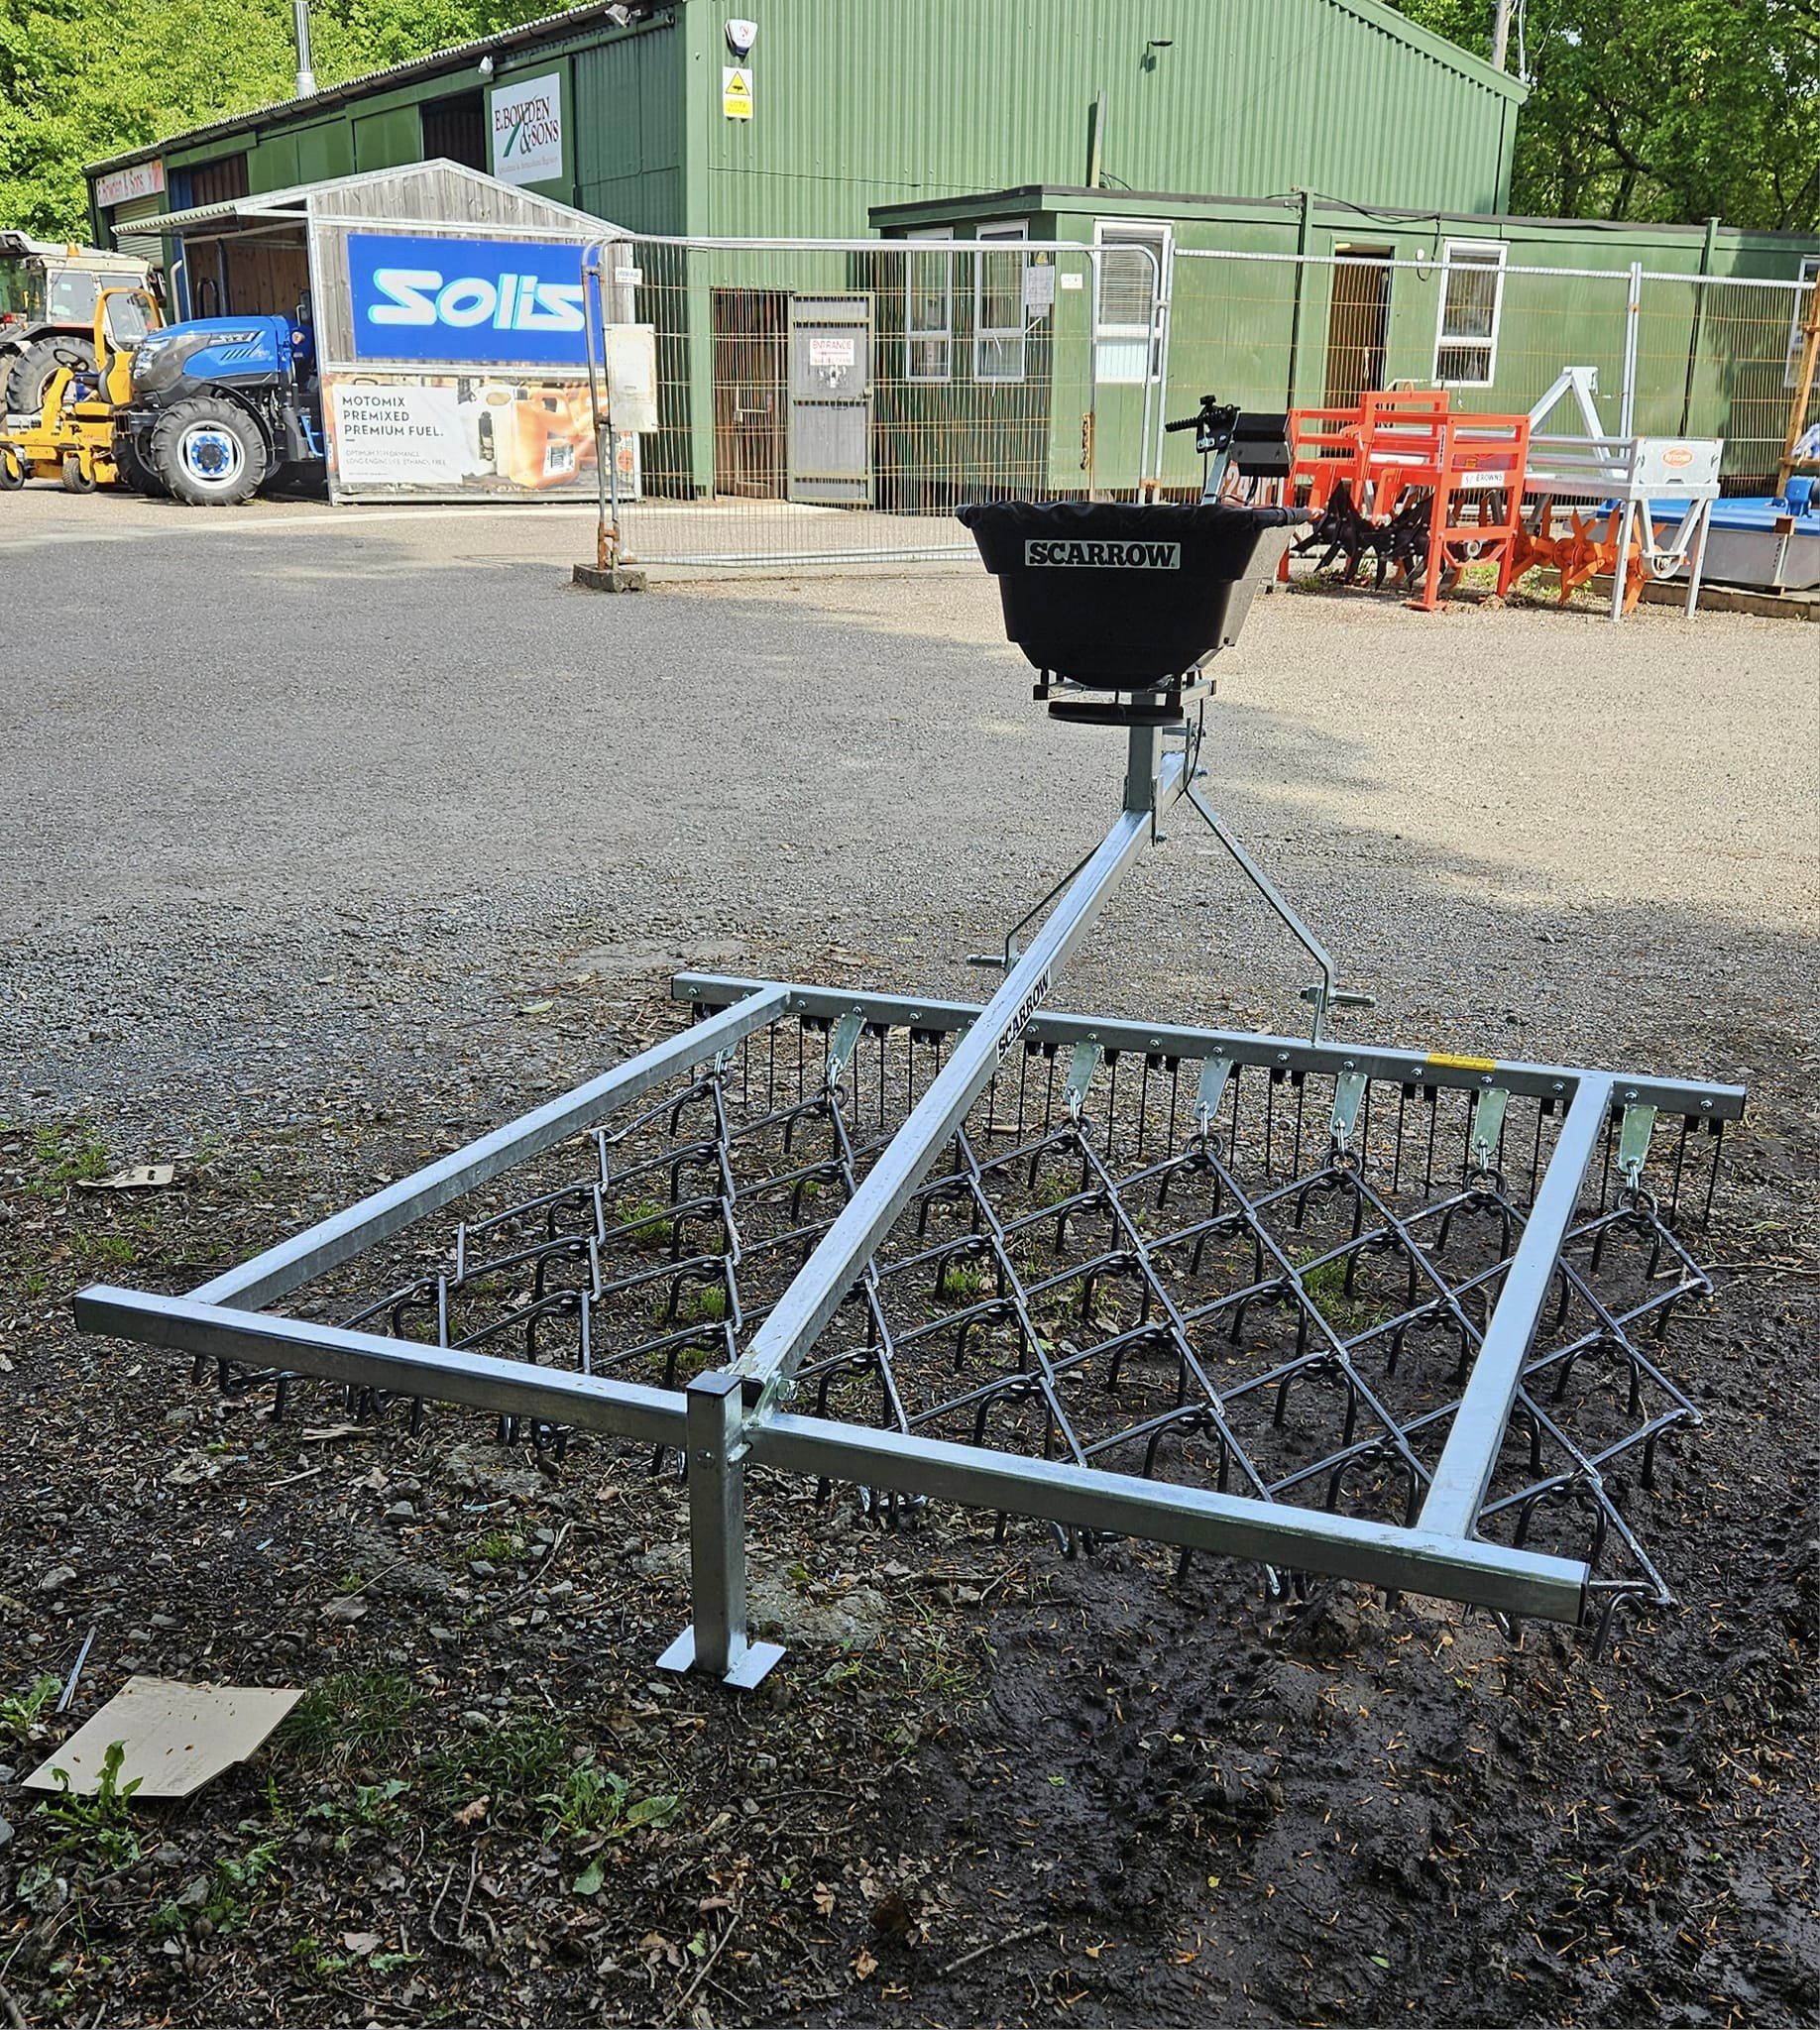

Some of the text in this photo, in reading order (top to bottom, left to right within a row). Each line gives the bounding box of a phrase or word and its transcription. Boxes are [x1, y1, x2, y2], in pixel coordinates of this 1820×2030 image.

[813, 340, 852, 350] ENTRANCE
[342, 395, 405, 406] MOTOMIX
[343, 409, 410, 422] PREMIXED
[344, 424, 444, 437] PREMIUM FUEL.
[1029, 542, 1176, 567] SCARROW
[998, 968, 1049, 1060] SCARROW
